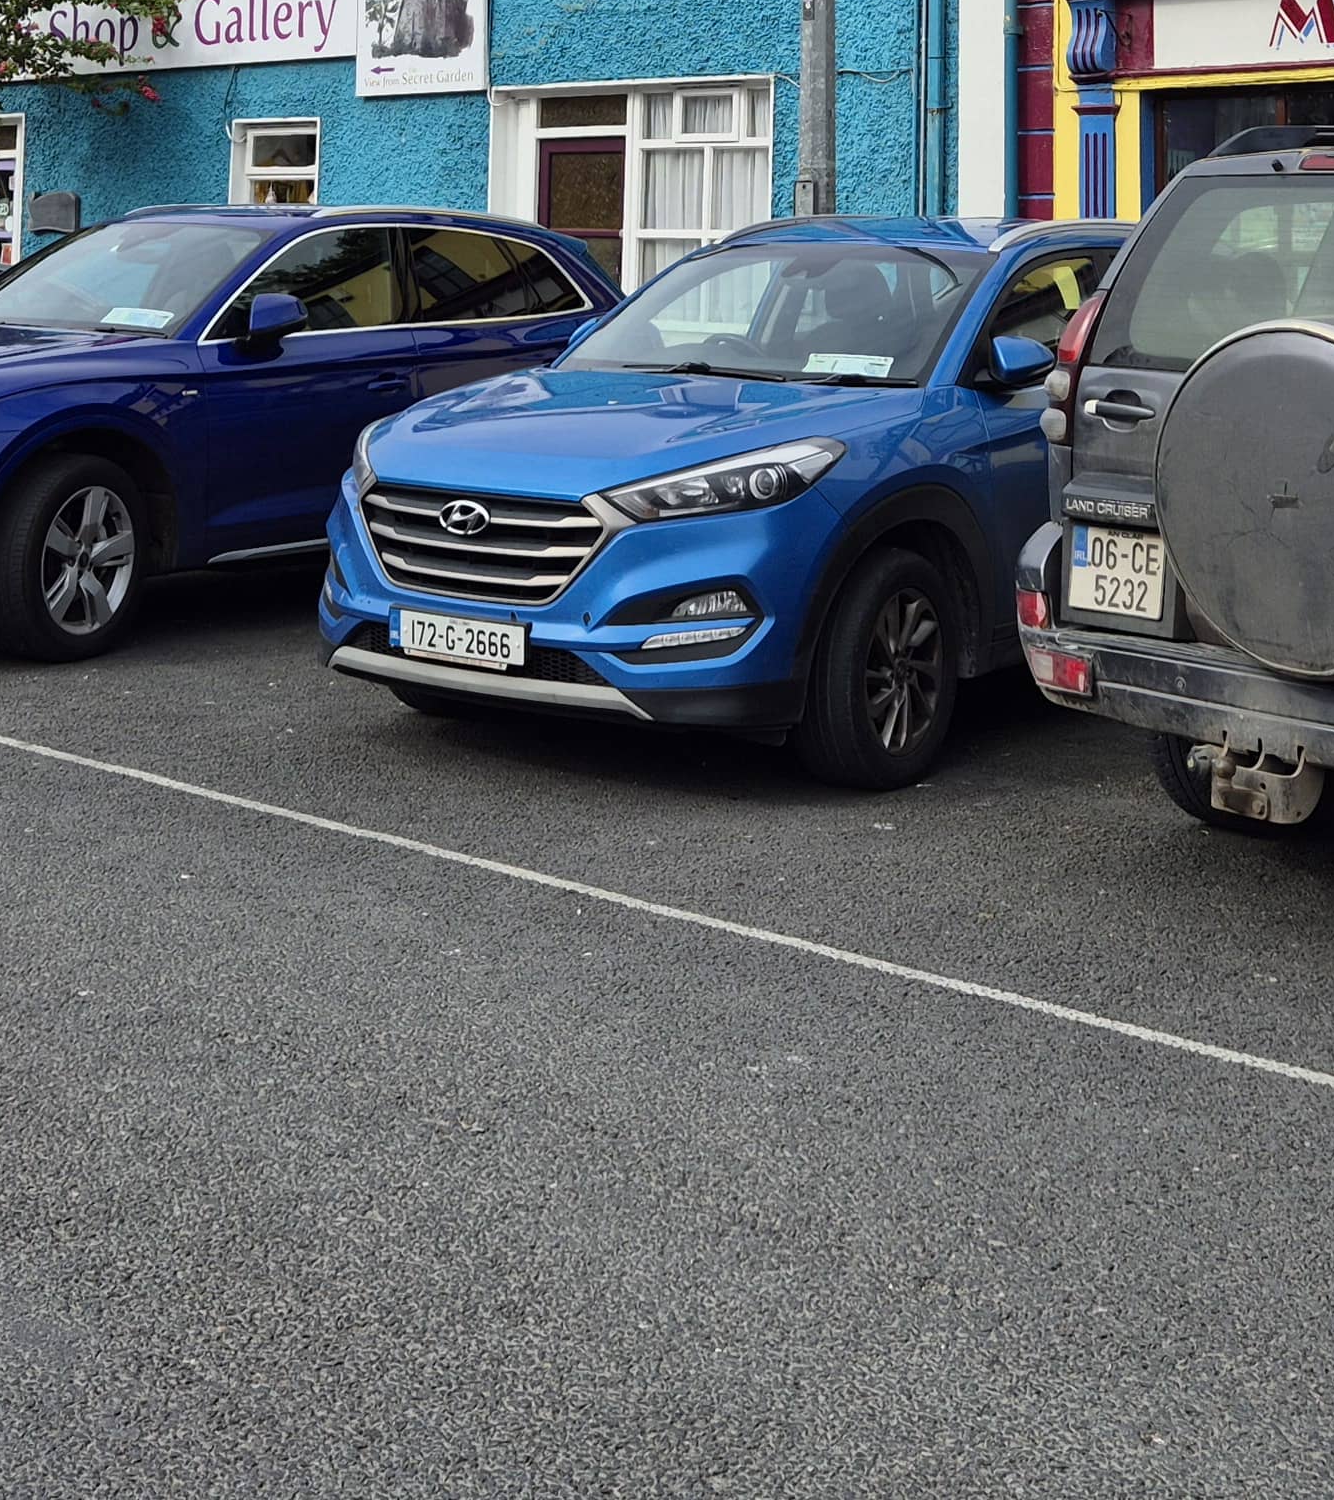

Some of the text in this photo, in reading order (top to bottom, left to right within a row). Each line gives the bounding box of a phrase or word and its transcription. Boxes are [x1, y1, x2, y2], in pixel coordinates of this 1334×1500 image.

[402, 71, 433, 85] Secret
[436, 68, 474, 84] Garden
[1066, 498, 1149, 519] LAND CRUISER
[1091, 536, 1159, 576] 06-CE
[1094, 574, 1148, 613] 5232
[410, 619, 511, 659] 172-G-2666
